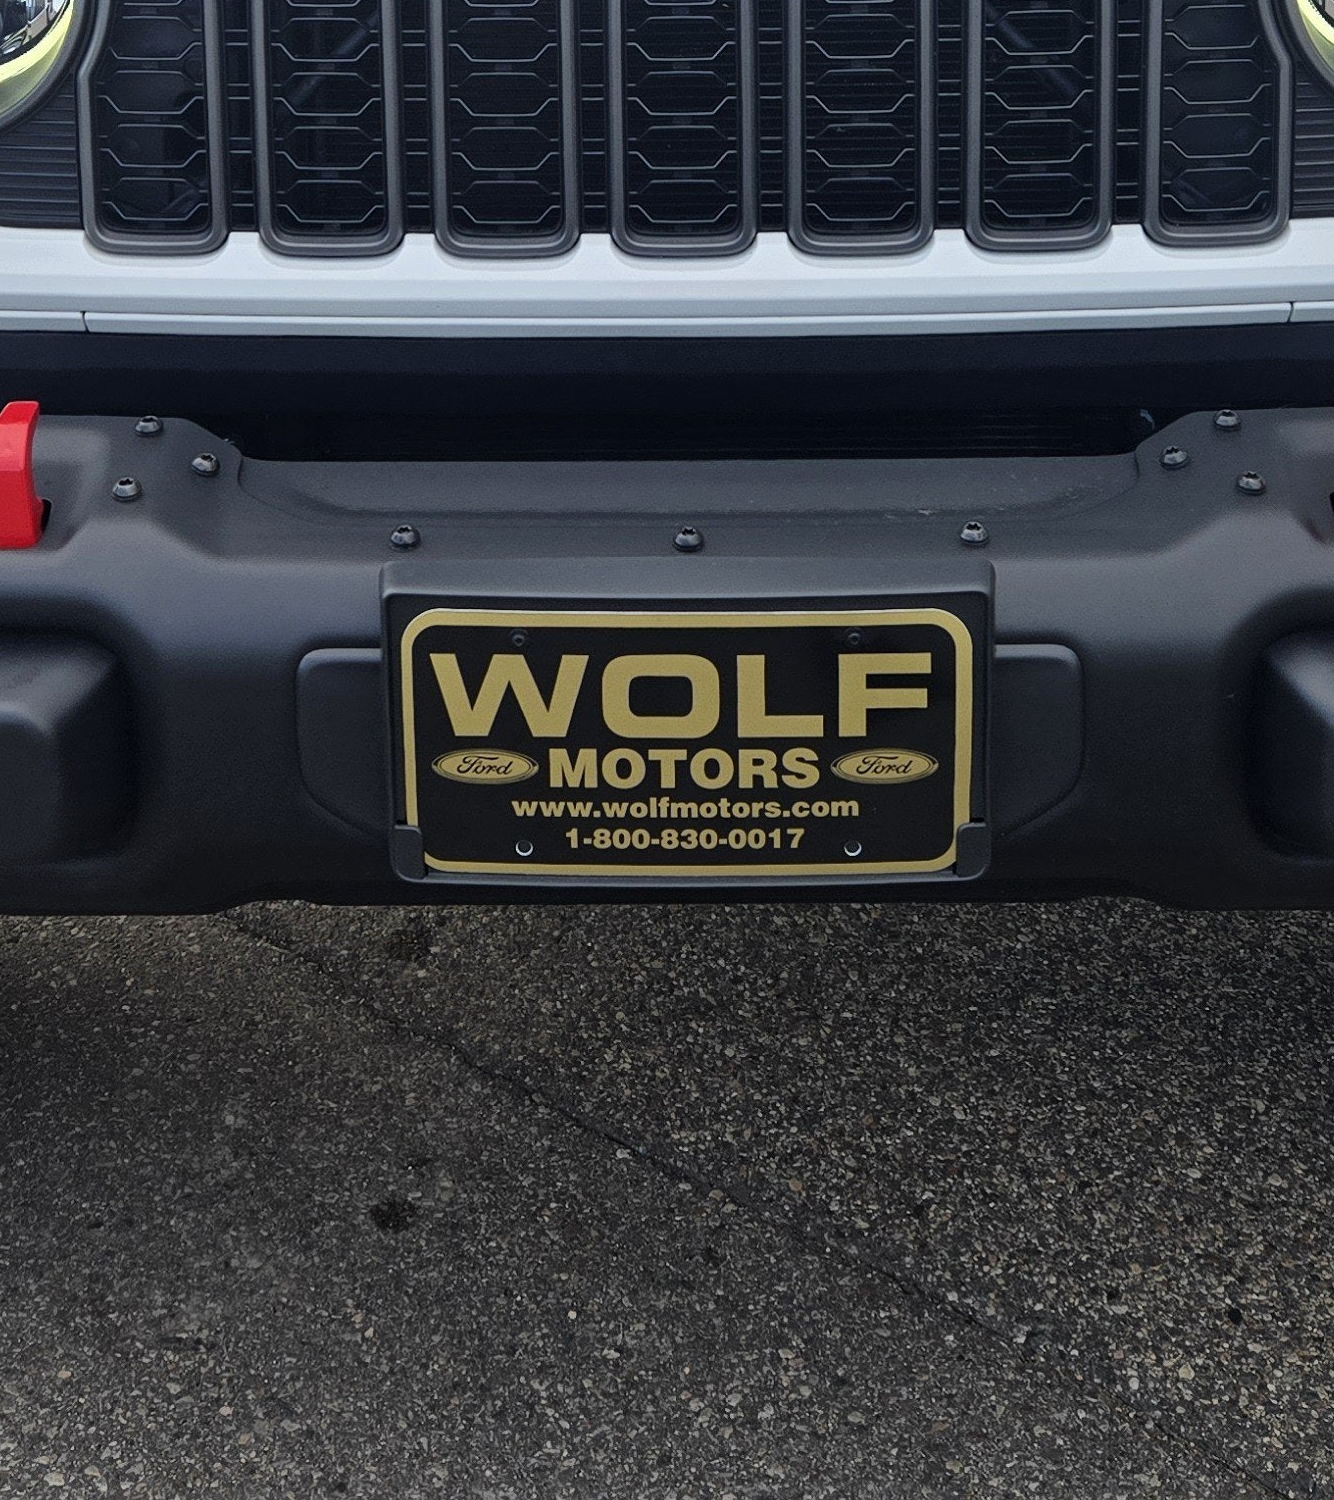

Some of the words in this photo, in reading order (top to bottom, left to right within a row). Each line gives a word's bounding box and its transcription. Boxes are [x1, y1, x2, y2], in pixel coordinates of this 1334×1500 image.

[429, 652, 932, 739] WOLF
[456, 756, 513, 777] Ford
[548, 747, 820, 789] MOTORS
[855, 756, 912, 777] Ford
[511, 796, 860, 819] www.wolfmotors.com
[565, 828, 806, 850] 1-800-830-0017
